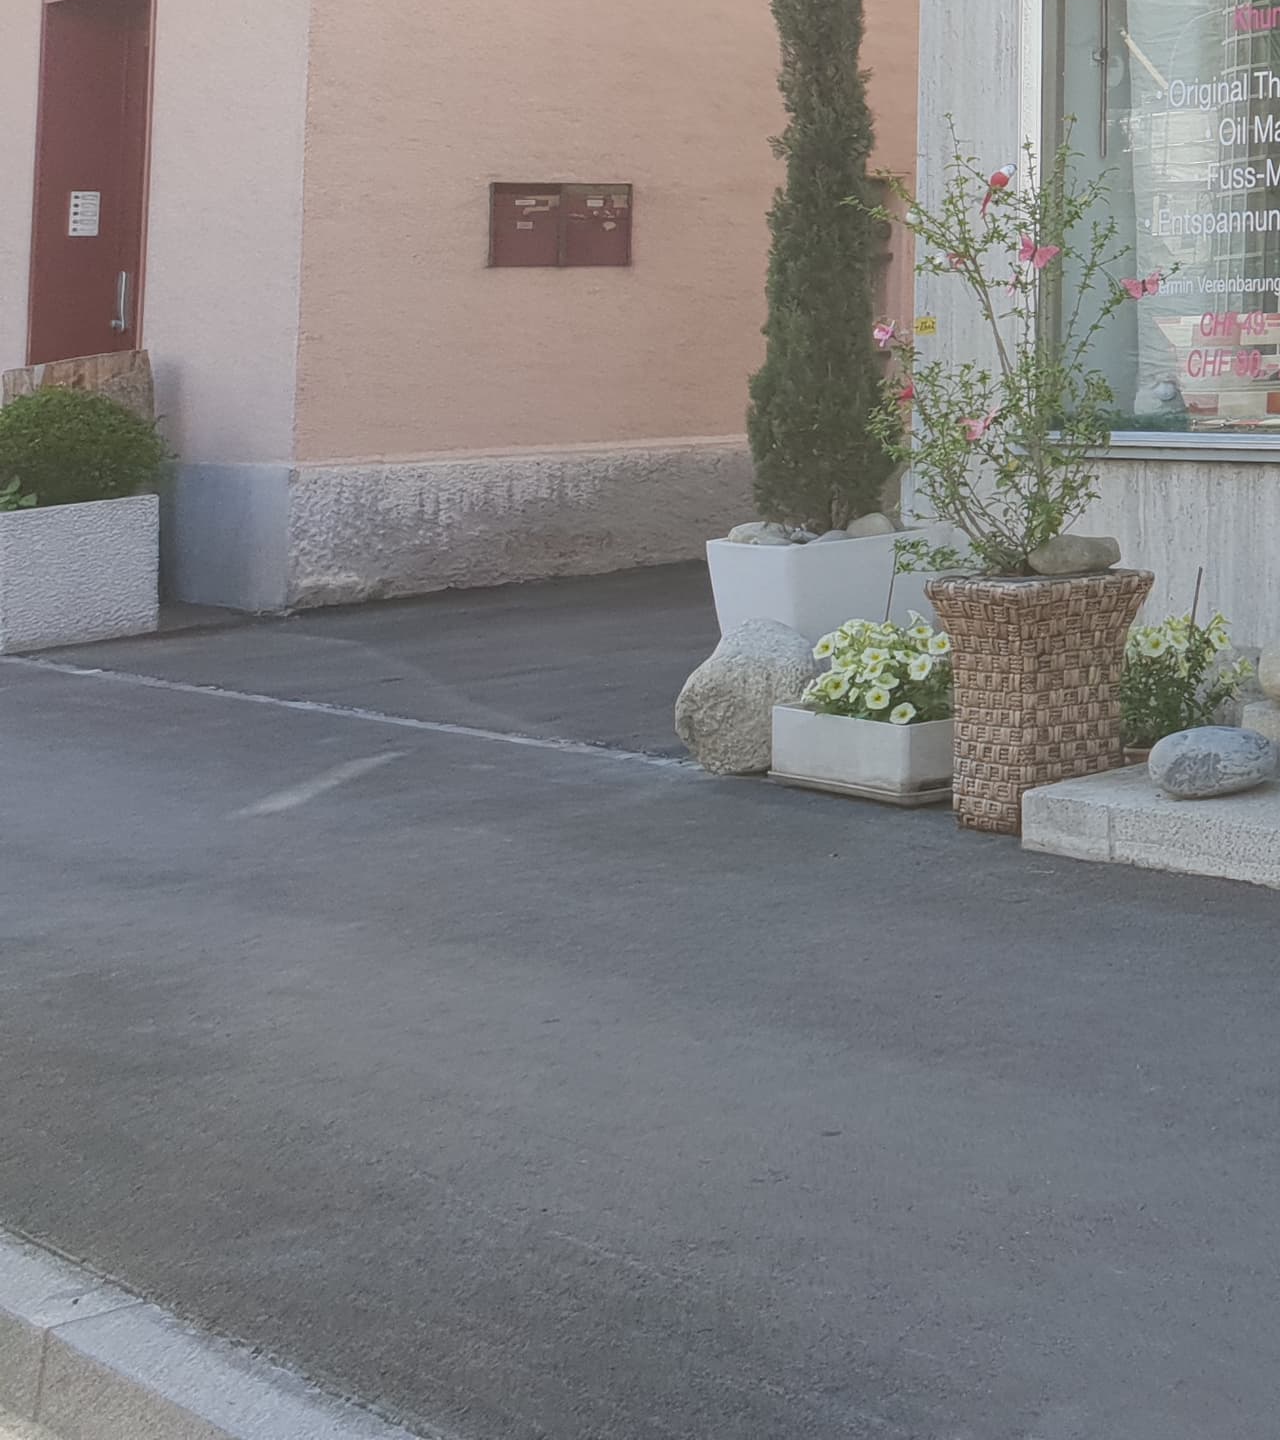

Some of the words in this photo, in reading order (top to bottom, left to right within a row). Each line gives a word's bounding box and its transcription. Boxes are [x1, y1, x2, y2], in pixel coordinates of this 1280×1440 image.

[1169, 73, 1248, 110] Original
[1219, 115, 1246, 146] Oil
[1157, 275, 1193, 295] ermin
[1200, 311, 1237, 337] CHF
[1187, 349, 1232, 378] CHF
